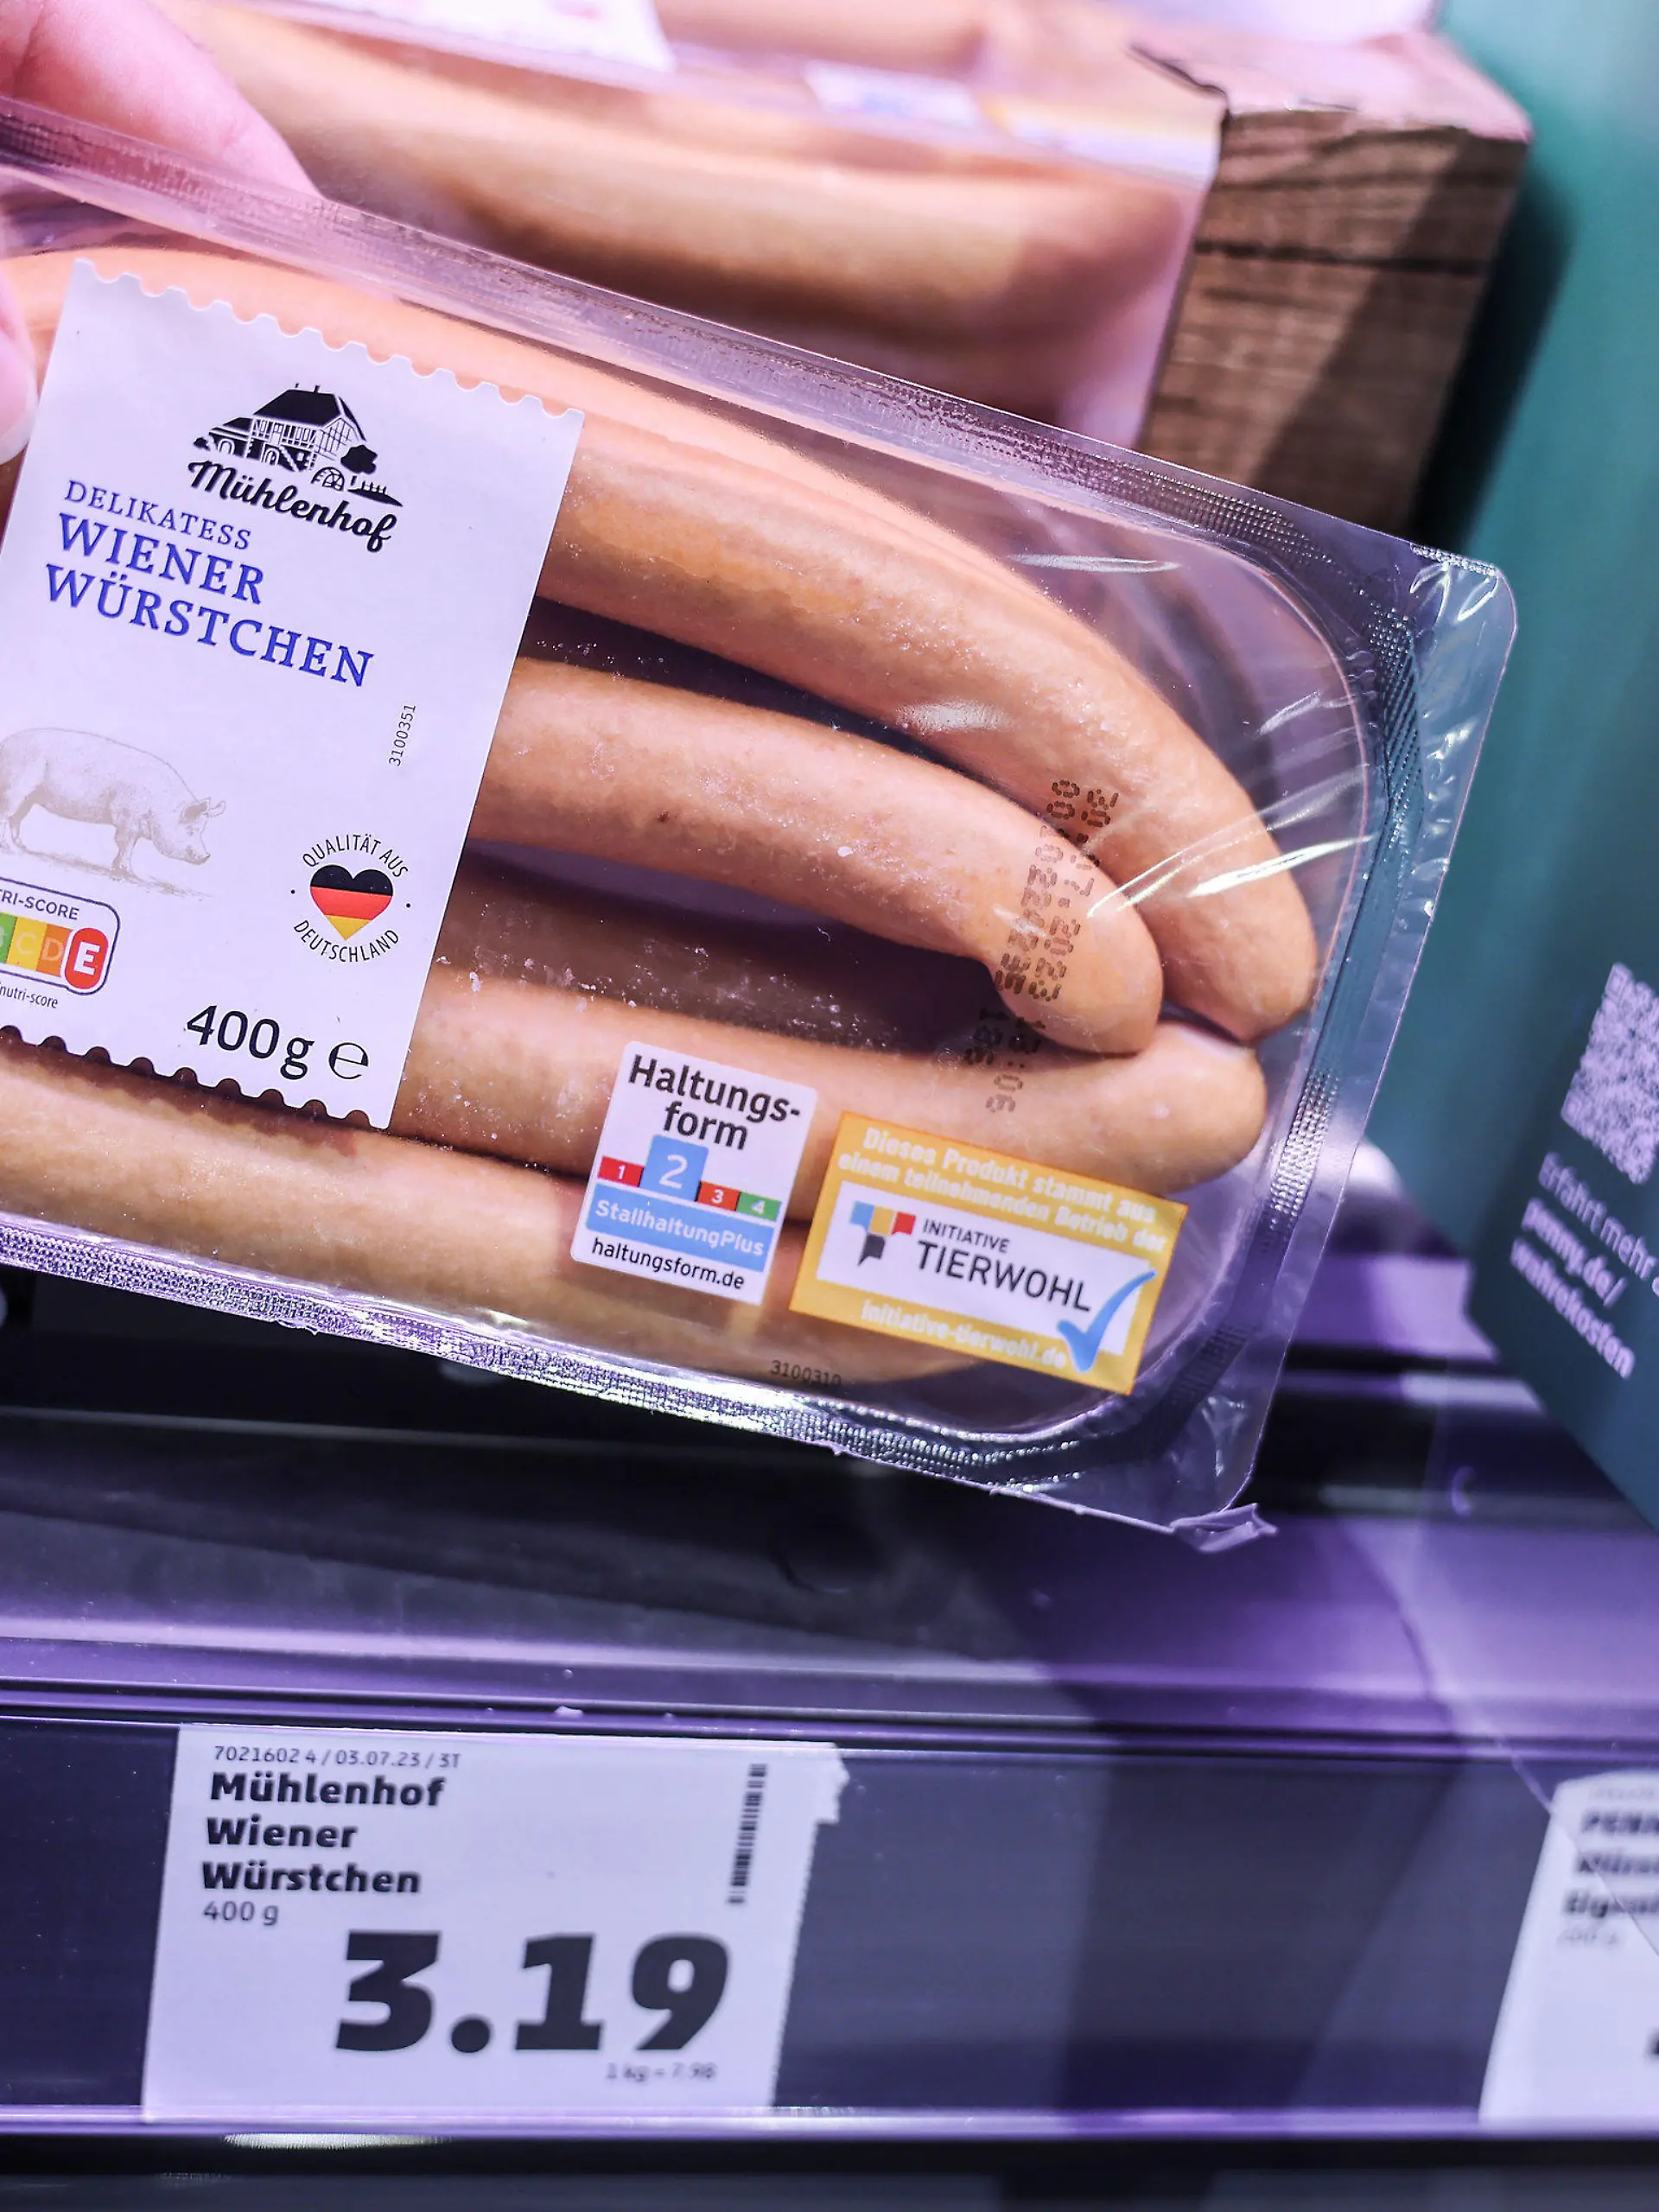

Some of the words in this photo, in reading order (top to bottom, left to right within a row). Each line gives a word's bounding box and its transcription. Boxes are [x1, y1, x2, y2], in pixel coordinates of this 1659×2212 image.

[65, 480, 251, 550] DELIKATESS
[188, 460, 397, 553] Mühlenhof
[60, 512, 264, 604] WIENER
[44, 563, 374, 688] WÜRSTCHEN
[388, 705, 416, 767] 3100351
[302, 833, 381, 868] QUALITÄT
[378, 849, 409, 878] AUS
[0, 889, 79, 920] RI-SCORE
[73, 941, 100, 976] E
[294, 919, 399, 963] DEUTSCHLAND
[0, 982, 59, 1008] nutri-score
[628, 1054, 800, 1123] Haltungs-
[663, 1101, 748, 1150] form
[617, 1165, 626, 1180] 1
[659, 1154, 688, 1189] 2
[711, 1188, 725, 1205] 3
[751, 1199, 766, 1215] 4
[838, 1151, 899, 1183] einem
[904, 1167, 1050, 1223] teilnehmenden
[1054, 1205, 1128, 1244] Betrieb
[1133, 1224, 1168, 1253] der
[863, 1127, 936, 1163] Dieses
[942, 1148, 1029, 1189] Produkt
[1033, 1175, 1114, 1211] stammt
[1119, 1198, 1155, 1224] aus
[595, 1199, 764, 1256] StallhaltungPlus
[923, 1218, 1010, 1254] INITIATIVE
[1600, 1217, 1658, 1281] mehr
[592, 1237, 745, 1289] haltungsform.de
[917, 1239, 1091, 1313] TIERWOHL
[335, 1749, 421, 1767] 03.07.23
[210, 1770, 447, 1807] Mühlenhof
[206, 1812, 359, 1849] Wiener
[201, 1859, 422, 1894] Würstchen
[203, 1901, 256, 1923] 400
[262, 1904, 279, 1928] g
[335, 1929, 729, 2054] 3.19
